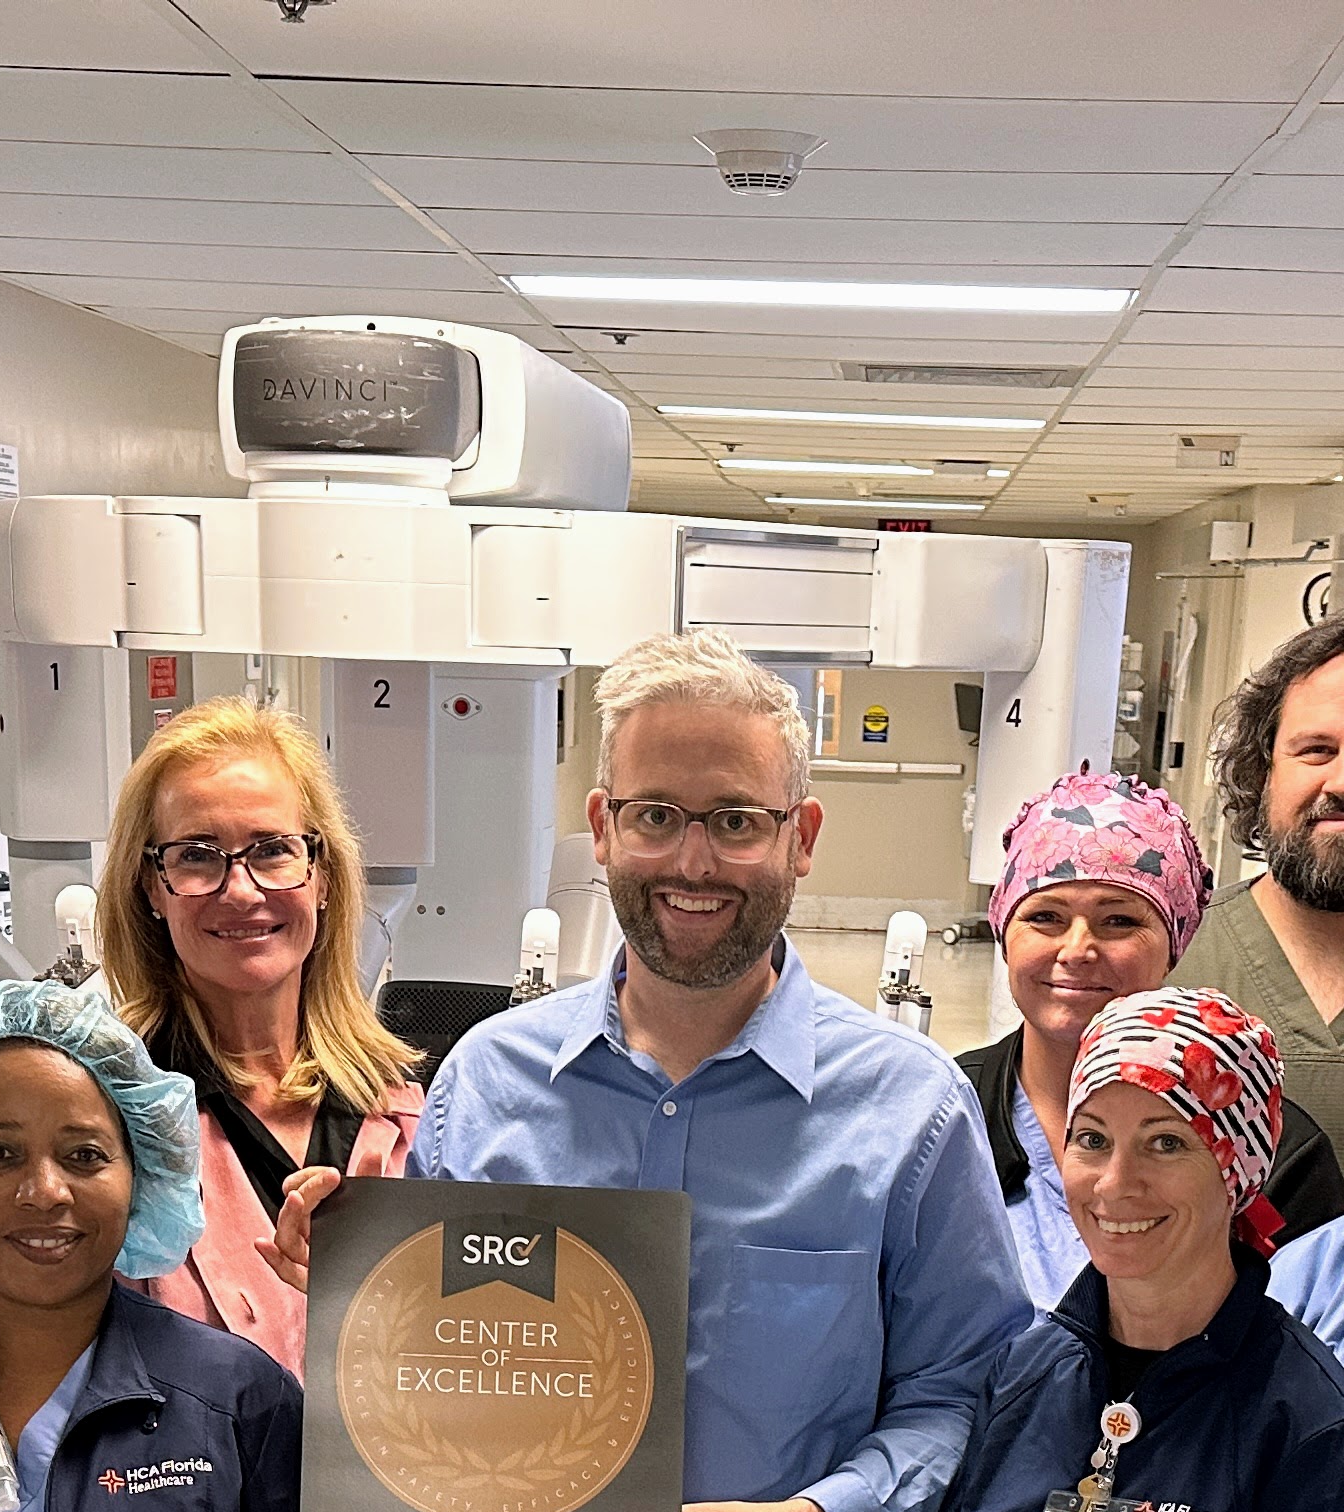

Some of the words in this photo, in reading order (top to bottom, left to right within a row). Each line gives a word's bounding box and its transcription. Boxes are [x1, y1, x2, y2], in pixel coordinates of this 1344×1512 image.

[50, 662, 59, 691] 1
[374, 679, 391, 709] 2
[1006, 698, 1022, 728] 4
[462, 1234, 530, 1267] SRC
[435, 1318, 558, 1347] CENTER
[353, 1279, 394, 1419] EXCELLENCE
[481, 1349, 511, 1367] OF
[602, 1289, 637, 1422] EFFICIENCY
[397, 1366, 594, 1398] EXCELLENCE
[372, 1436, 389, 1456] IN
[608, 1438, 619, 1447] &
[126, 1465, 160, 1482] HCA
[161, 1457, 213, 1474] Florida
[128, 1475, 194, 1495] Healthcare
[398, 1467, 472, 1511] SAFETY
